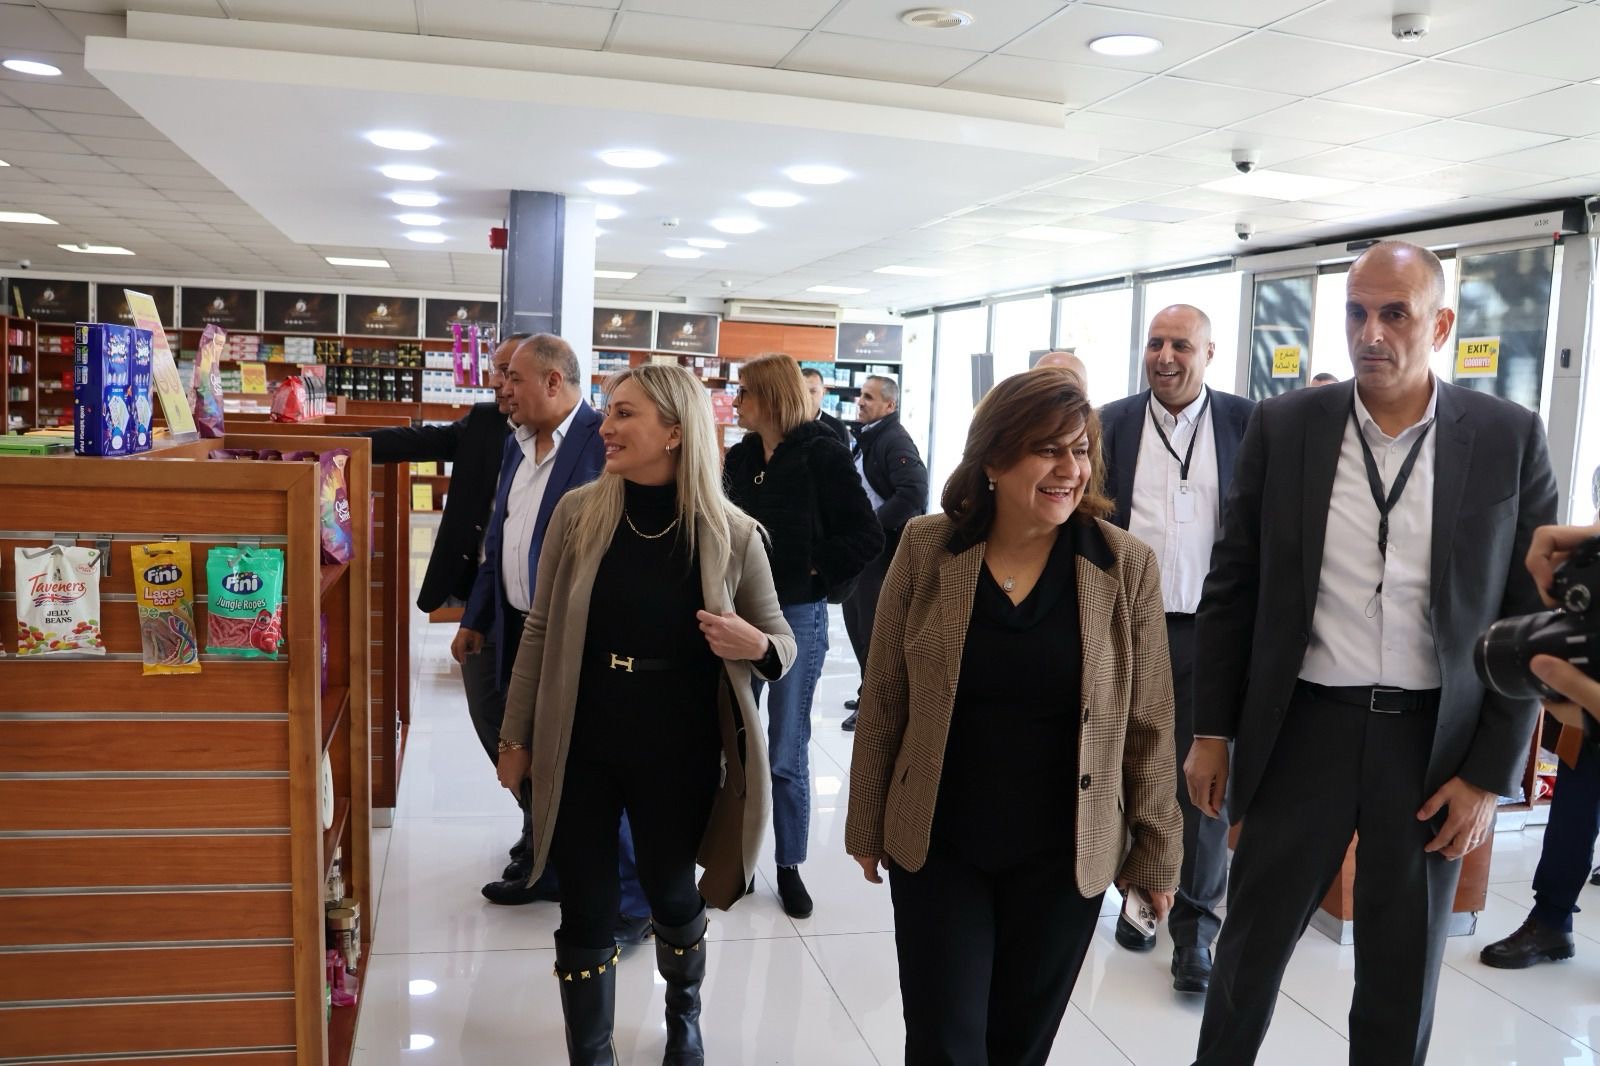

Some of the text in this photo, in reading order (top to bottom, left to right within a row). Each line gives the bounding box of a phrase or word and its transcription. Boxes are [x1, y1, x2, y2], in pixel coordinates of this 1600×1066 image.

[1468, 343, 1489, 354] EXIT
[147, 566, 178, 584] Fini
[28, 572, 87, 596] Taveners
[225, 574, 258, 592] Fini
[144, 587, 184, 600] Laces
[217, 597, 266, 612] Jungle Ropes
[45, 616, 72, 624] BEANS
[47, 609, 70, 617] JELLY
